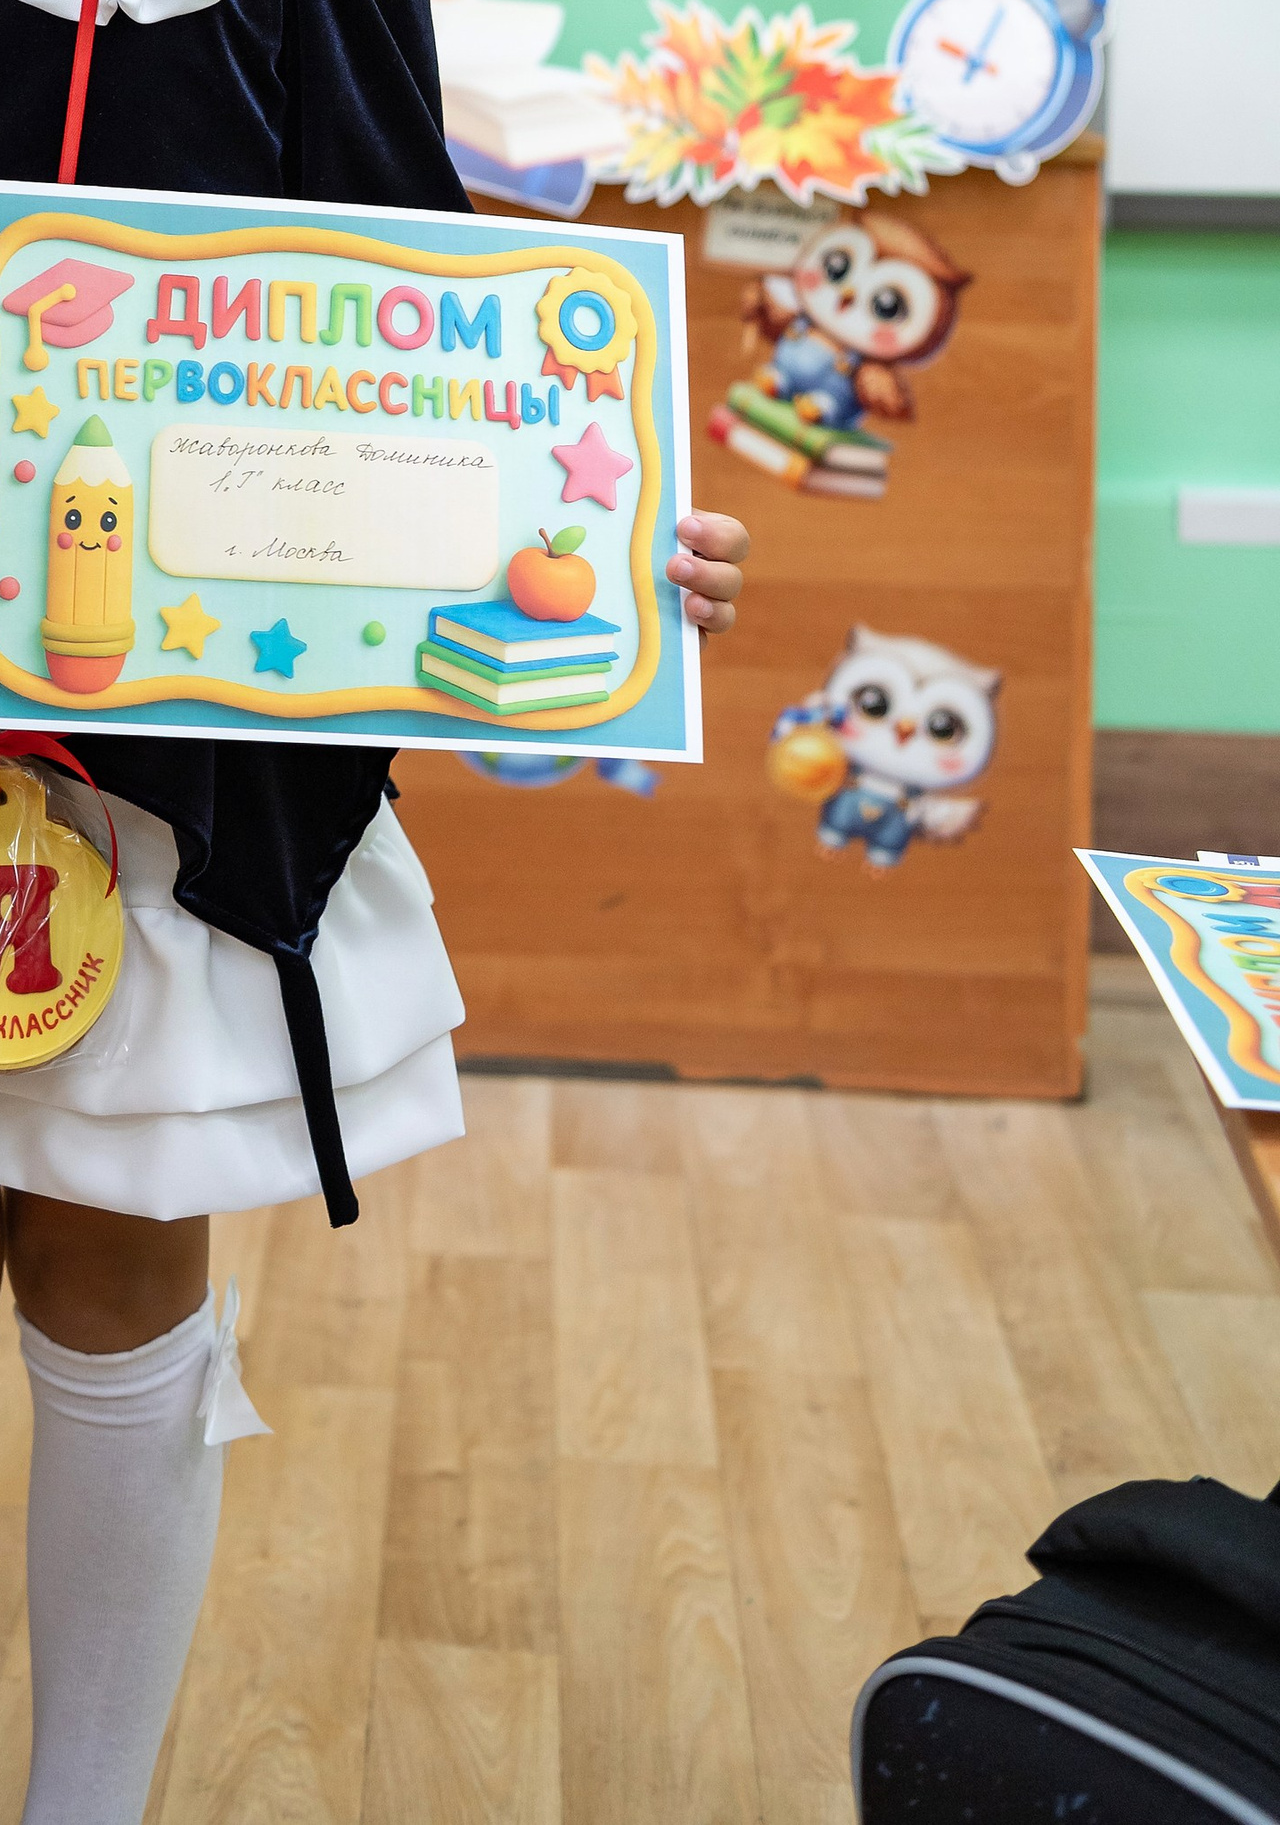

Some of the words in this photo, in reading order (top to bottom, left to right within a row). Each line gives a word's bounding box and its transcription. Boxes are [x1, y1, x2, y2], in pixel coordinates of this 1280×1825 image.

[146, 273, 502, 360] ДИПЛОМ
[76, 357, 561, 430] ПЕРВОКЛАССНИЦЫ
[271, 477, 346, 496] класс
[251, 536, 354, 562] Москва
